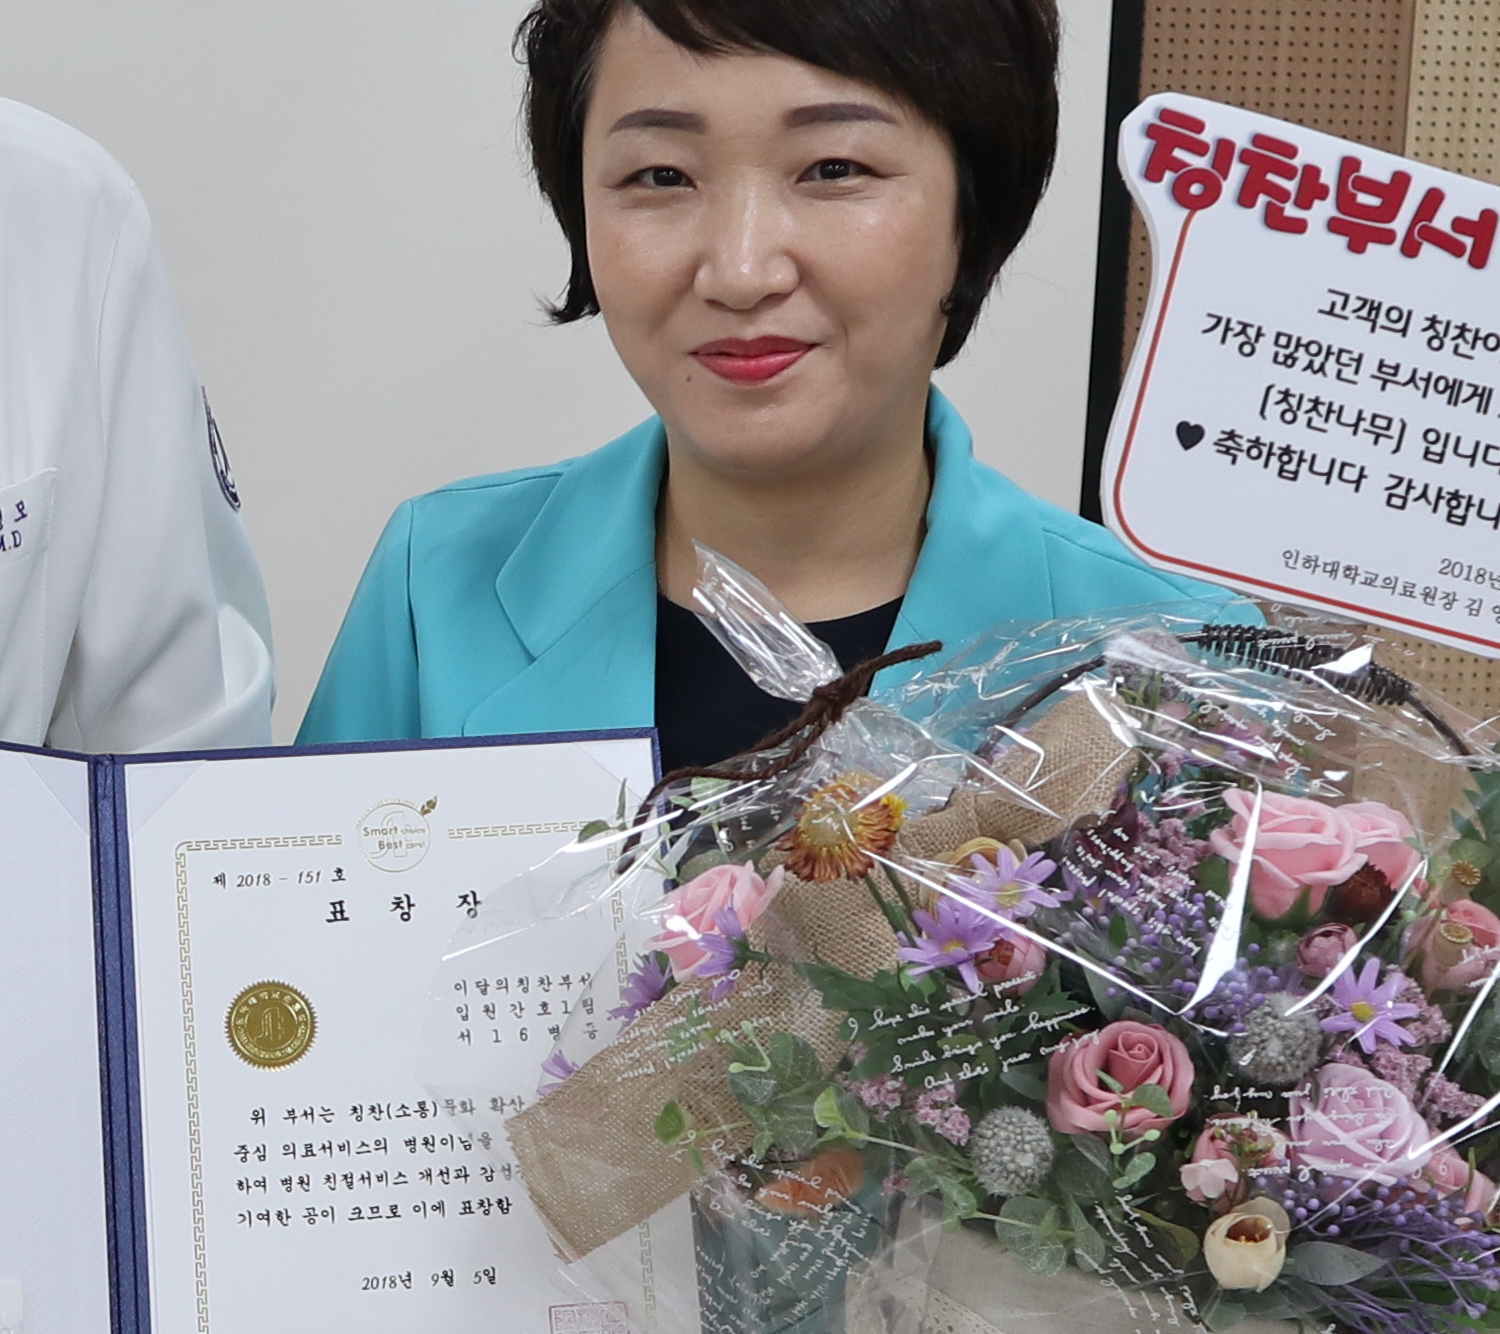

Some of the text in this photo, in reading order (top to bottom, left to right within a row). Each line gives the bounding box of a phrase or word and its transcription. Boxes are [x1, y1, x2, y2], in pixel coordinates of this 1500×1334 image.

[1144, 108, 1498, 270] 칭찬부서
[1317, 288, 1413, 337] 고객의
[1201, 313, 1266, 358] 가장
[1272, 331, 1364, 385] 많았던
[1370, 358, 1493, 416] 부서에게
[1213, 429, 1368, 494] 축하합니다
[1282, 549, 1458, 611] 인하대학교의료원장
[363, 826, 398, 836] Smart
[378, 840, 402, 850] Best
[213, 872, 226, 889] 제
[236, 874, 271, 888] 2018
[297, 870, 321, 884] 151
[331, 867, 346, 882] 호
[250, 1107, 266, 1127] 위
[282, 1106, 335, 1125] 부서는
[233, 1143, 268, 1163] 중심
[282, 1137, 388, 1159] 의료서비스의
[236, 1176, 267, 1195] 하여
[280, 1174, 310, 1193] 병원
[322, 1170, 409, 1191] 친절서비스
[418, 1166, 470, 1186] 개선과
[238, 1196, 513, 1228] 기여한 공이 크므로 이에 표창함
[361, 1266, 496, 1290] 2018년 9월 5일
